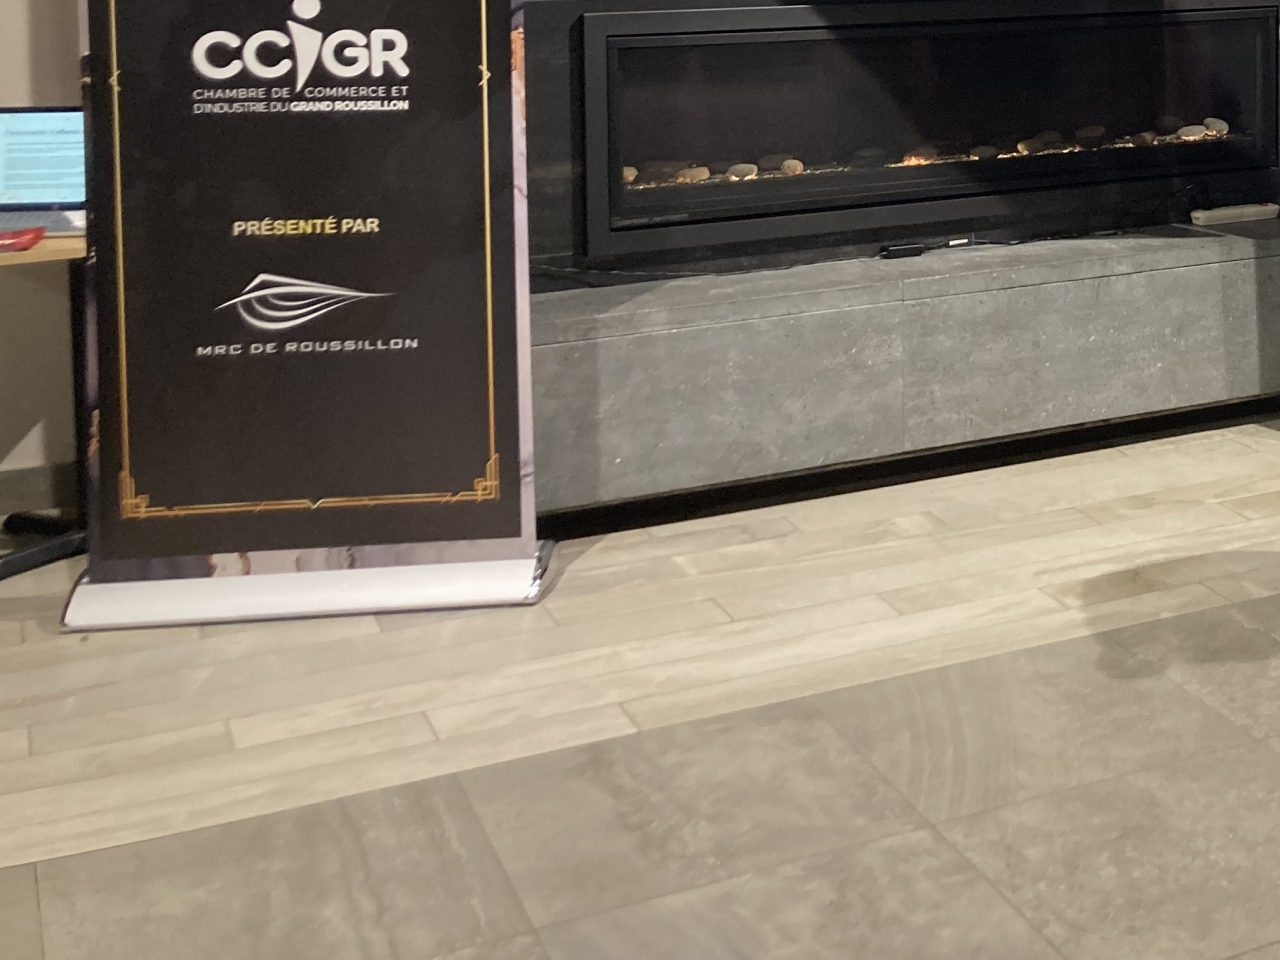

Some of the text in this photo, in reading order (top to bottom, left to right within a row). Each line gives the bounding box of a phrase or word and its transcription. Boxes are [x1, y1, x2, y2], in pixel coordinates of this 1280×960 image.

[193, 85, 408, 99] CHAMBRE DE COMMERCE ET
[193, 100, 409, 113] D'INDUSTRIE DU GRAND ROUSSILLON
[233, 217, 379, 237] PRÉSENTÉ PAR
[196, 338, 418, 356] MRC DE ROUSSILLON
